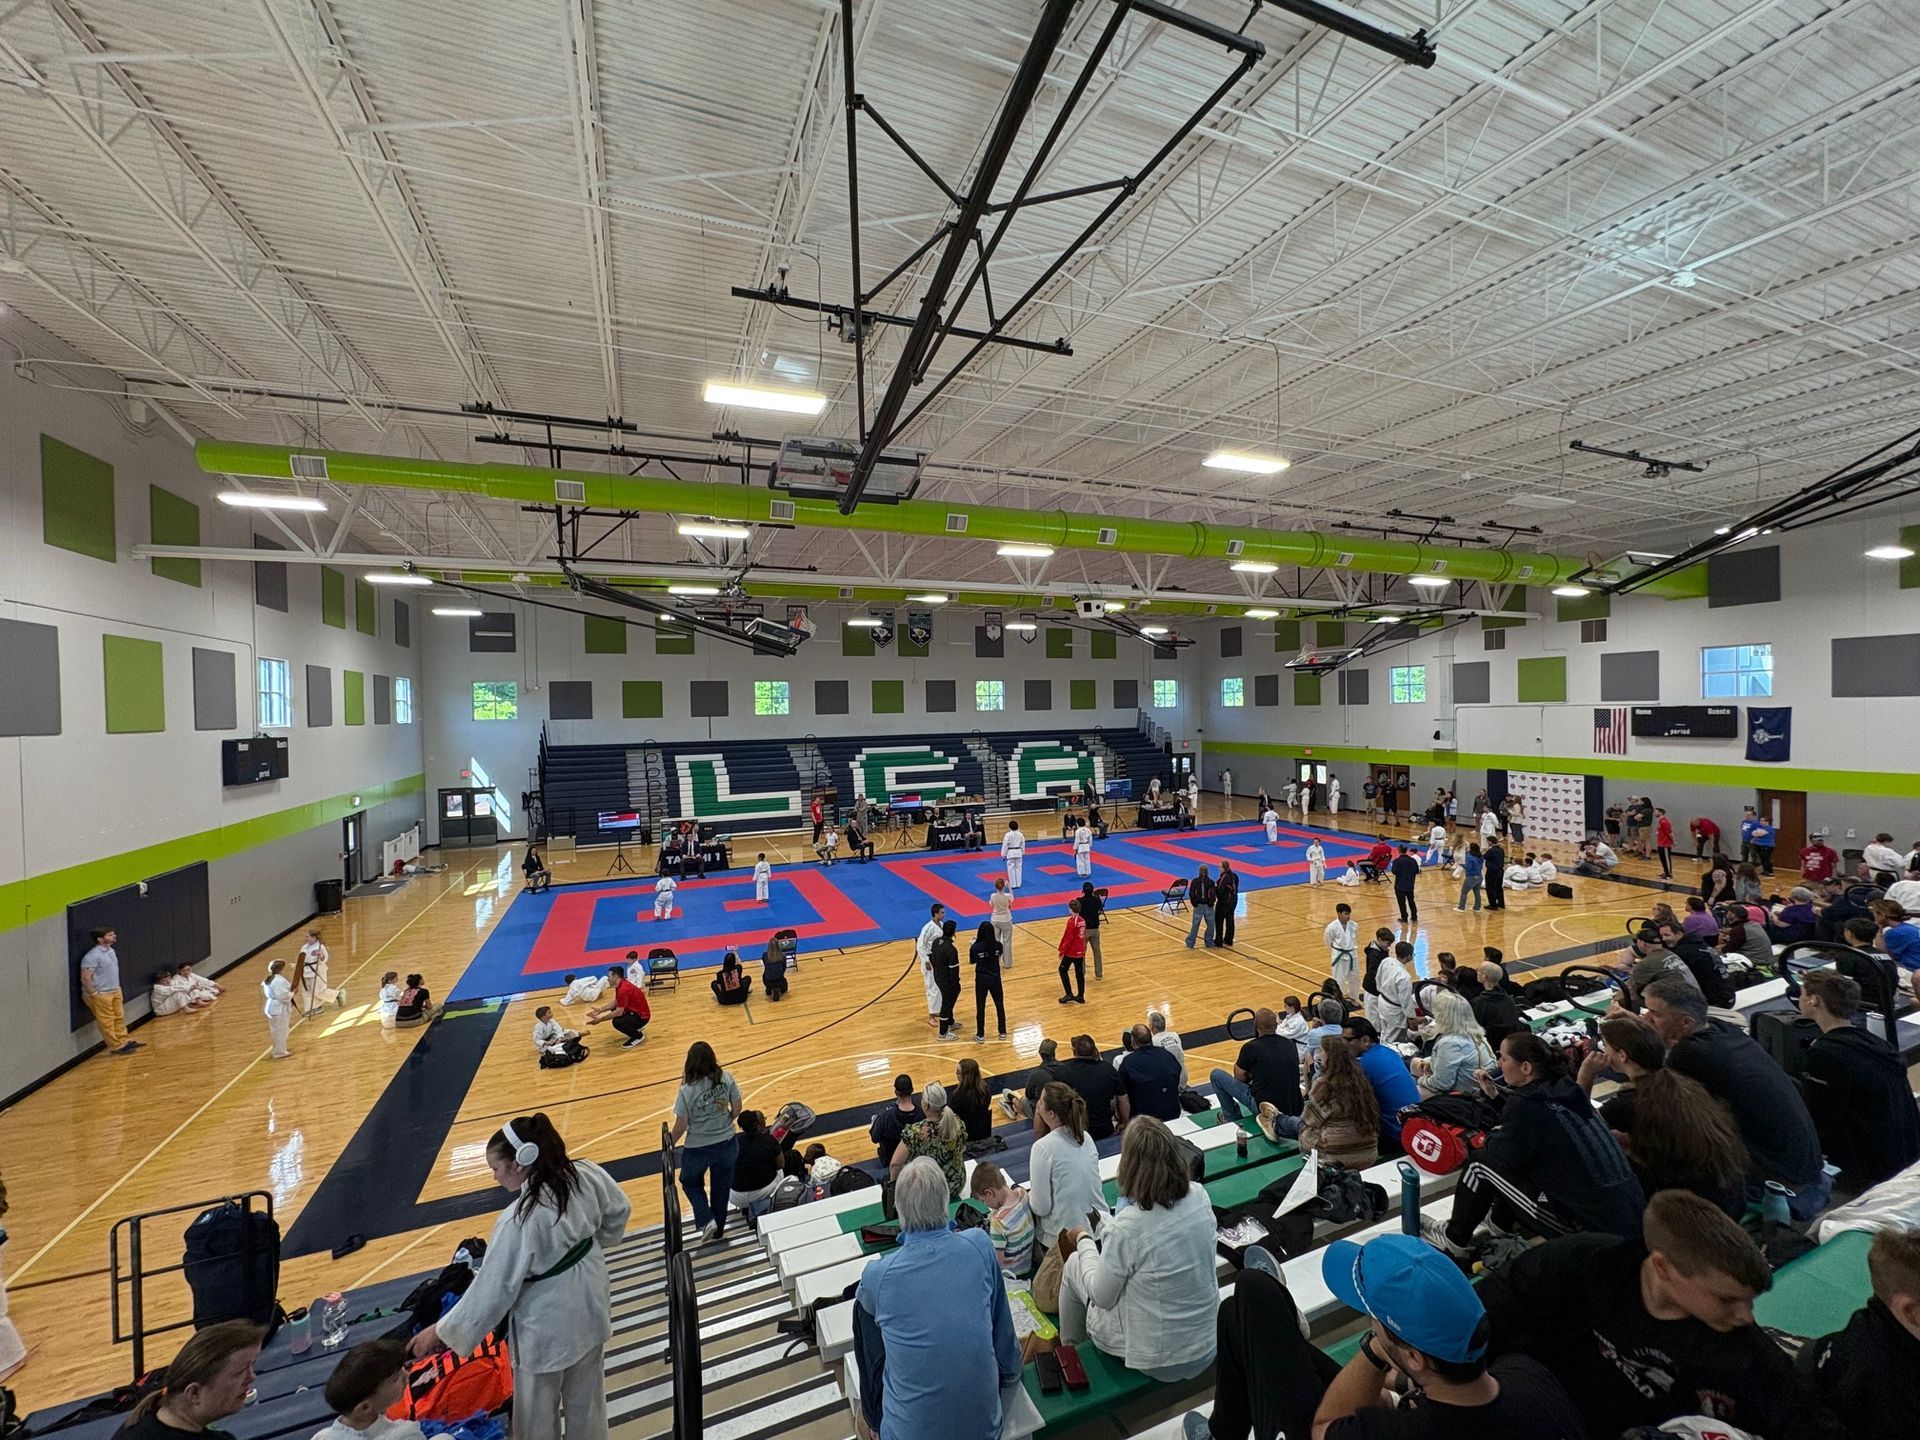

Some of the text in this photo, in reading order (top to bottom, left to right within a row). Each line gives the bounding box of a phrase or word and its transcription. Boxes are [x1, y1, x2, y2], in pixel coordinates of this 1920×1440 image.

[1670, 728, 1691, 736] period
[1152, 814, 1179, 823] TATAM
[715, 852, 720, 862] 1
